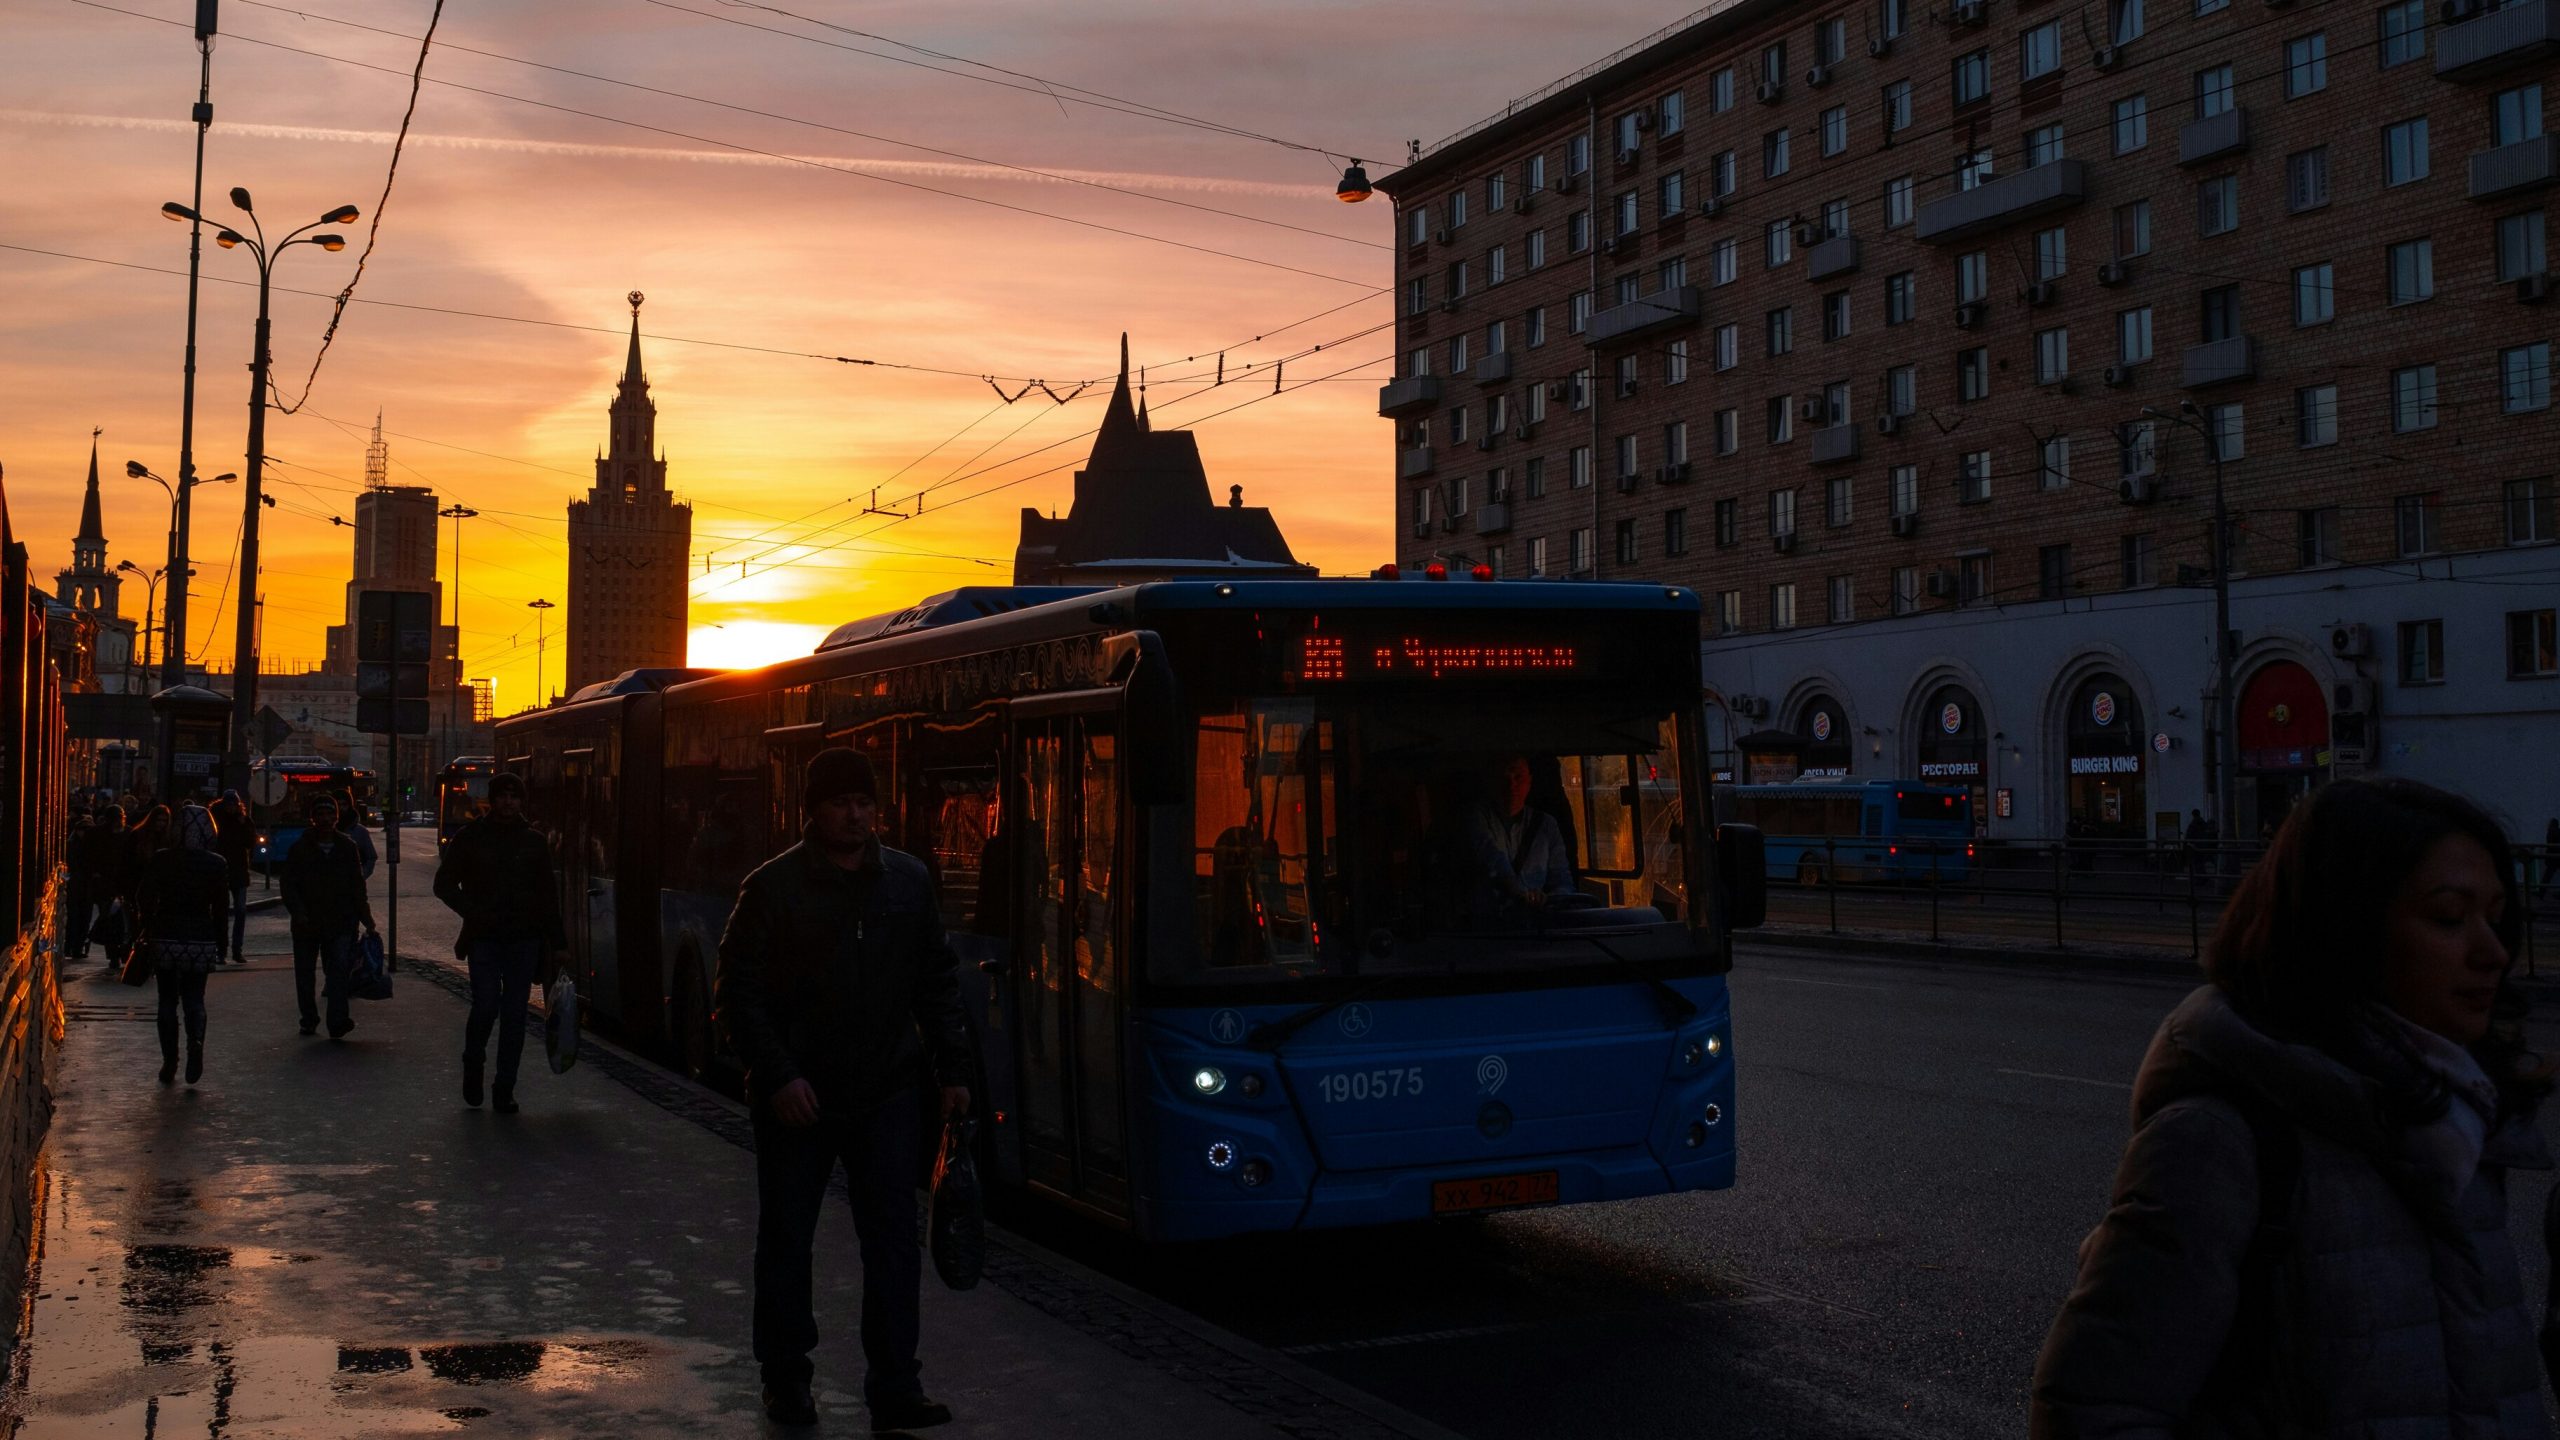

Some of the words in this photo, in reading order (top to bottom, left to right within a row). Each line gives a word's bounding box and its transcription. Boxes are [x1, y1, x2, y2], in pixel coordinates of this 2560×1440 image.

[1921, 763, 1980, 776] РЕСТОРАН
[2071, 757, 2111, 774] BURGER
[2112, 755, 2139, 773] KING
[1318, 1066, 1425, 1103] 190575
[1480, 1180, 1519, 1203] 942
[1532, 1174, 1552, 1193] 77
